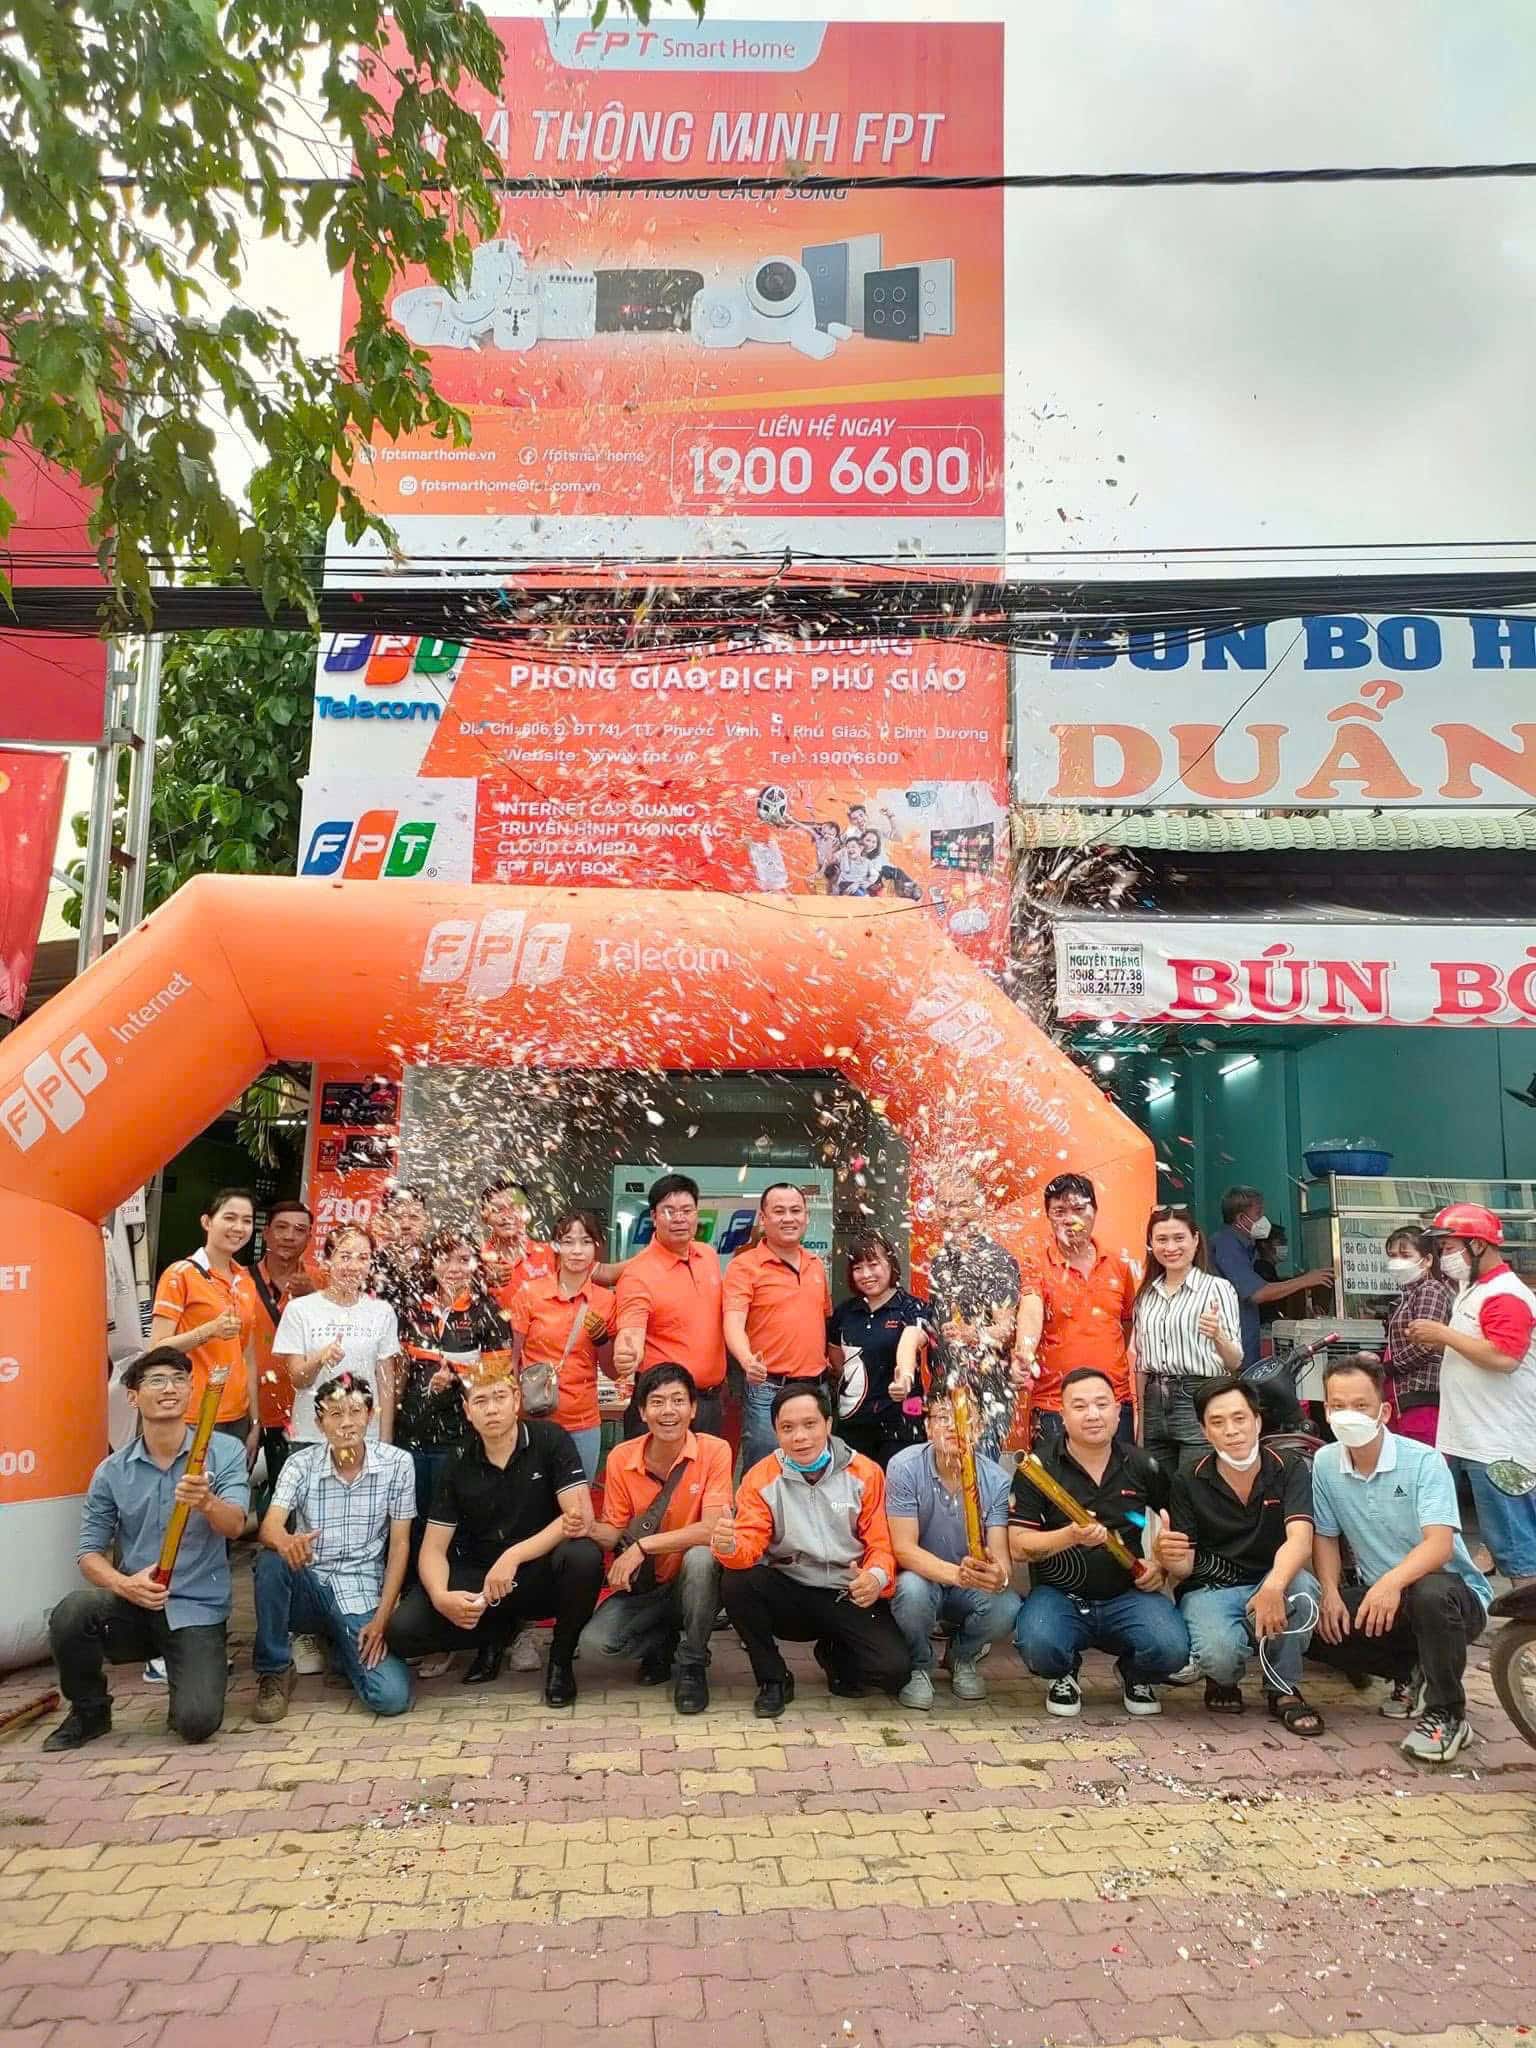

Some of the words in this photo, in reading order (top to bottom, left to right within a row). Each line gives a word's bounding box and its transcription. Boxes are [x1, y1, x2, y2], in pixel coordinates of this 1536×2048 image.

[575, 32, 658, 55] FPT
[662, 38, 725, 58] Smart
[732, 39, 795, 58] Home
[532, 101, 695, 163] THÔNG
[706, 112, 841, 163] MINH
[852, 112, 946, 163] FPT
[758, 415, 802, 437] LIÊN
[807, 414, 836, 440] HỆ
[840, 418, 897, 437] NGAY
[381, 448, 496, 461] fptsmarthome.vn
[543, 450, 644, 462] /fptsmarhome
[689, 446, 812, 496] 1900
[830, 446, 970, 496] 6600
[631, 666, 708, 690] GIAO
[719, 666, 794, 695] DỊCH
[811, 662, 875, 690] PHÚ
[891, 662, 967, 691] GIÁO
[315, 694, 441, 721] Telecom
[1047, 679, 1536, 799] DUẨN
[631, 804, 696, 817] QUANG
[497, 841, 558, 856] CLOUD
[533, 861, 577, 875] PLAY
[581, 861, 619, 875] BOX
[594, 937, 729, 972] Telecom
[1070, 982, 1142, 994] 08.24.77.39
[1166, 943, 1394, 1018] BÚN
[109, 970, 193, 1045] Internet
[5, 1044, 99, 1140] FPT
